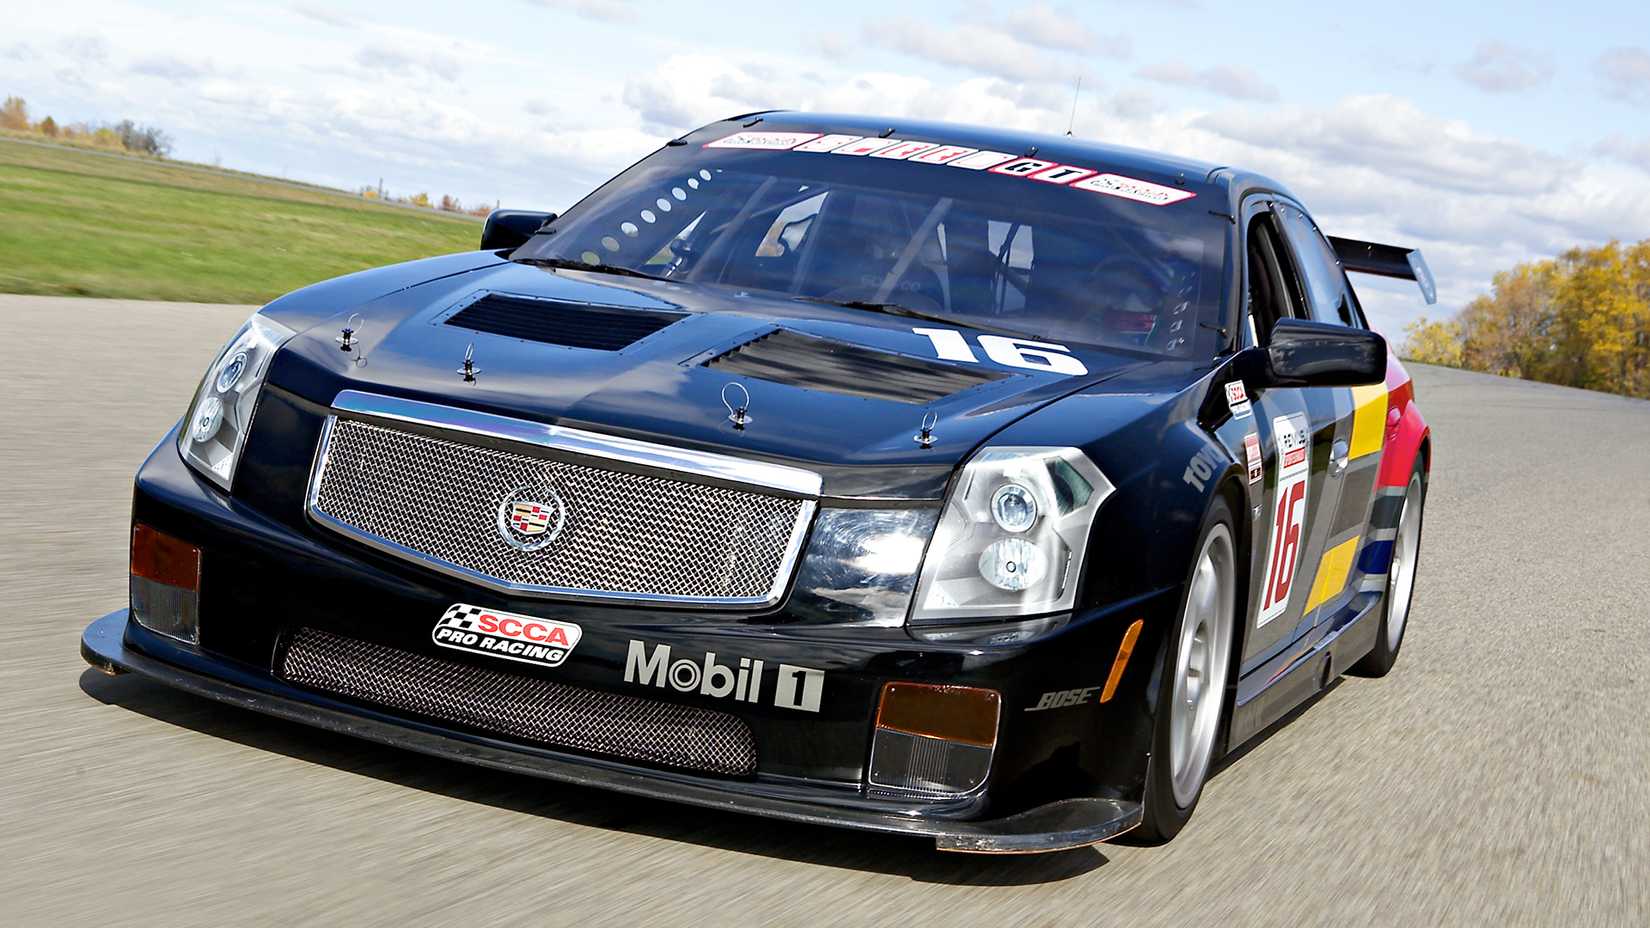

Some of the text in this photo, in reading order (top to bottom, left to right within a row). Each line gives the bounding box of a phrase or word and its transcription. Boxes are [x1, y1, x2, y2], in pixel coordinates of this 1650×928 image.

[1005, 162, 1081, 179] GT
[911, 327, 1089, 376] 16
[1263, 480, 1306, 612] 16
[437, 628, 565, 663] PRO RACING
[477, 612, 570, 647] SCCA
[623, 640, 765, 704] Mobil
[1024, 686, 1102, 711] BOSE
